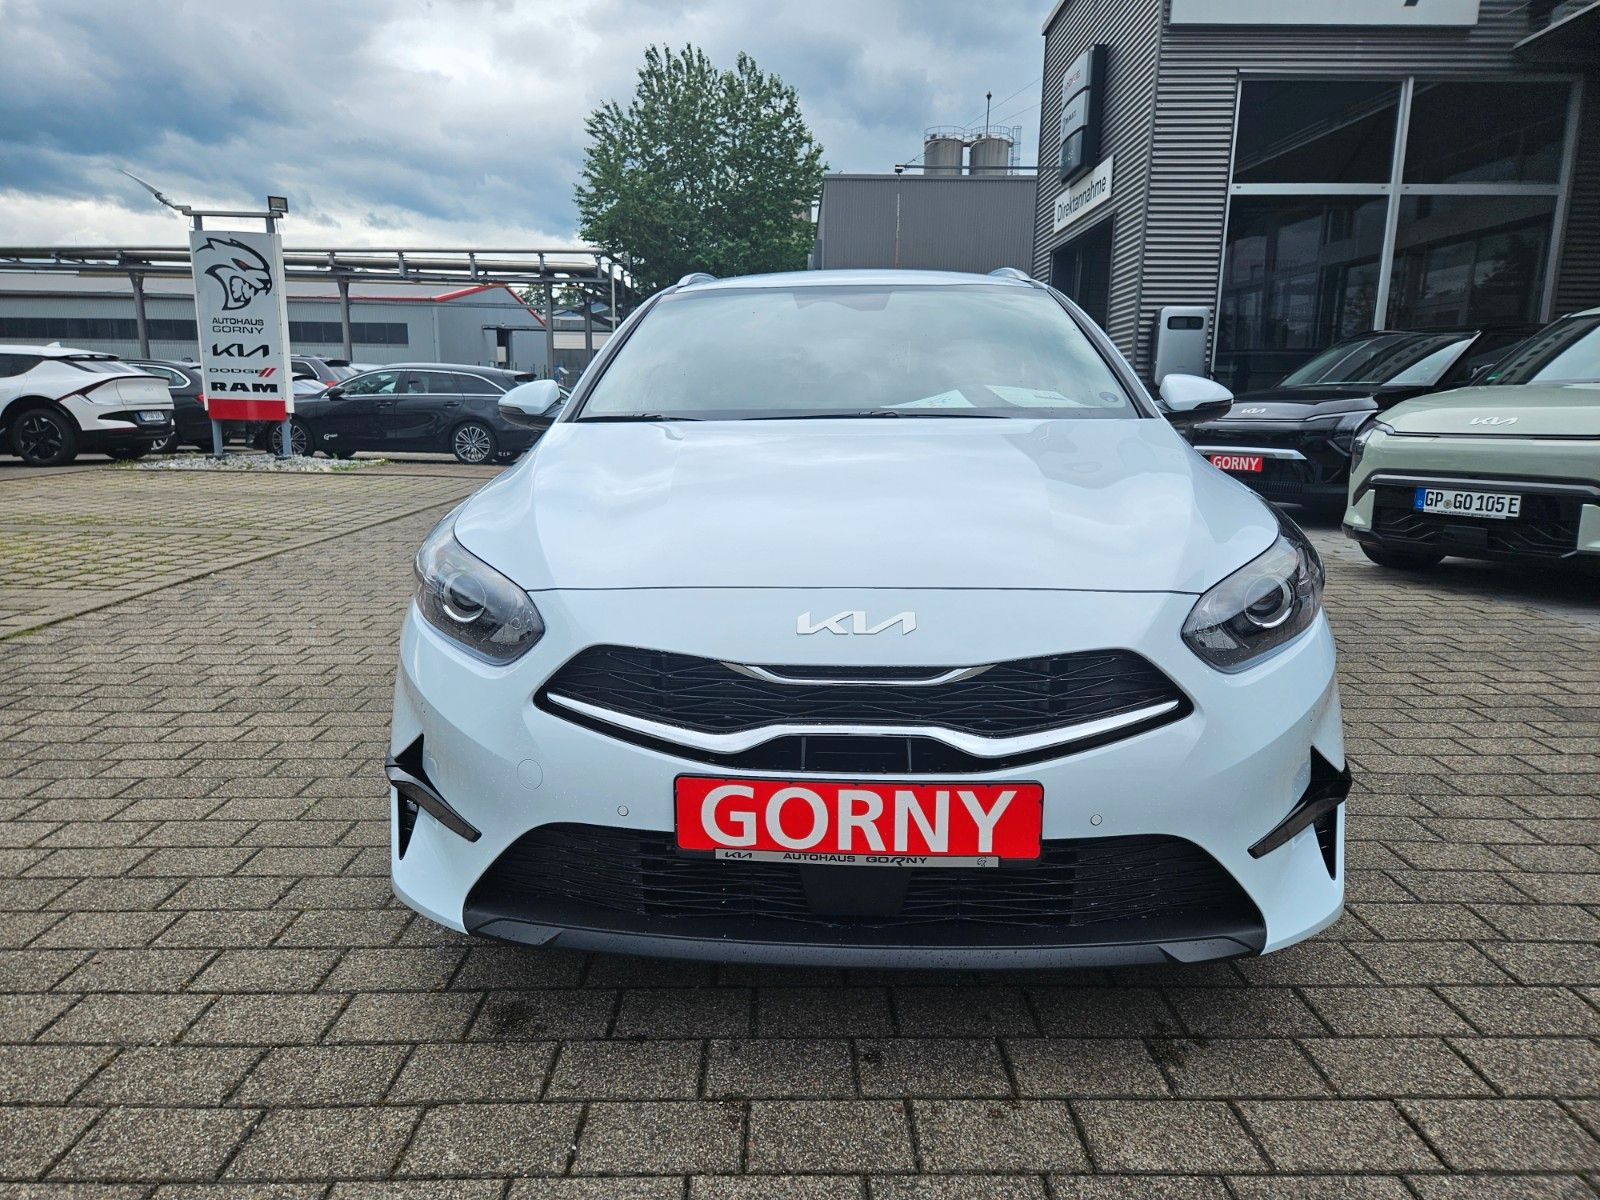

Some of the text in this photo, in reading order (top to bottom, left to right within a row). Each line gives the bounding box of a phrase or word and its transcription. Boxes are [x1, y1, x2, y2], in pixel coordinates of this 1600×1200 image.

[1057, 176, 1107, 222] Direktannahme
[212, 317, 264, 326] AUTOHAUS
[212, 325, 264, 334] GORNY
[212, 343, 270, 358] KIA
[211, 382, 278, 393] RAM
[1469, 416, 1518, 425] KIA
[1213, 455, 1259, 471] GORNY
[1425, 491, 1444, 507] GP
[1453, 493, 1474, 510] GO
[796, 611, 917, 635] KIA
[700, 784, 1018, 854] GORNY
[724, 851, 752, 859] KIA
[783, 852, 928, 866] AUTOHAUS GORNY
